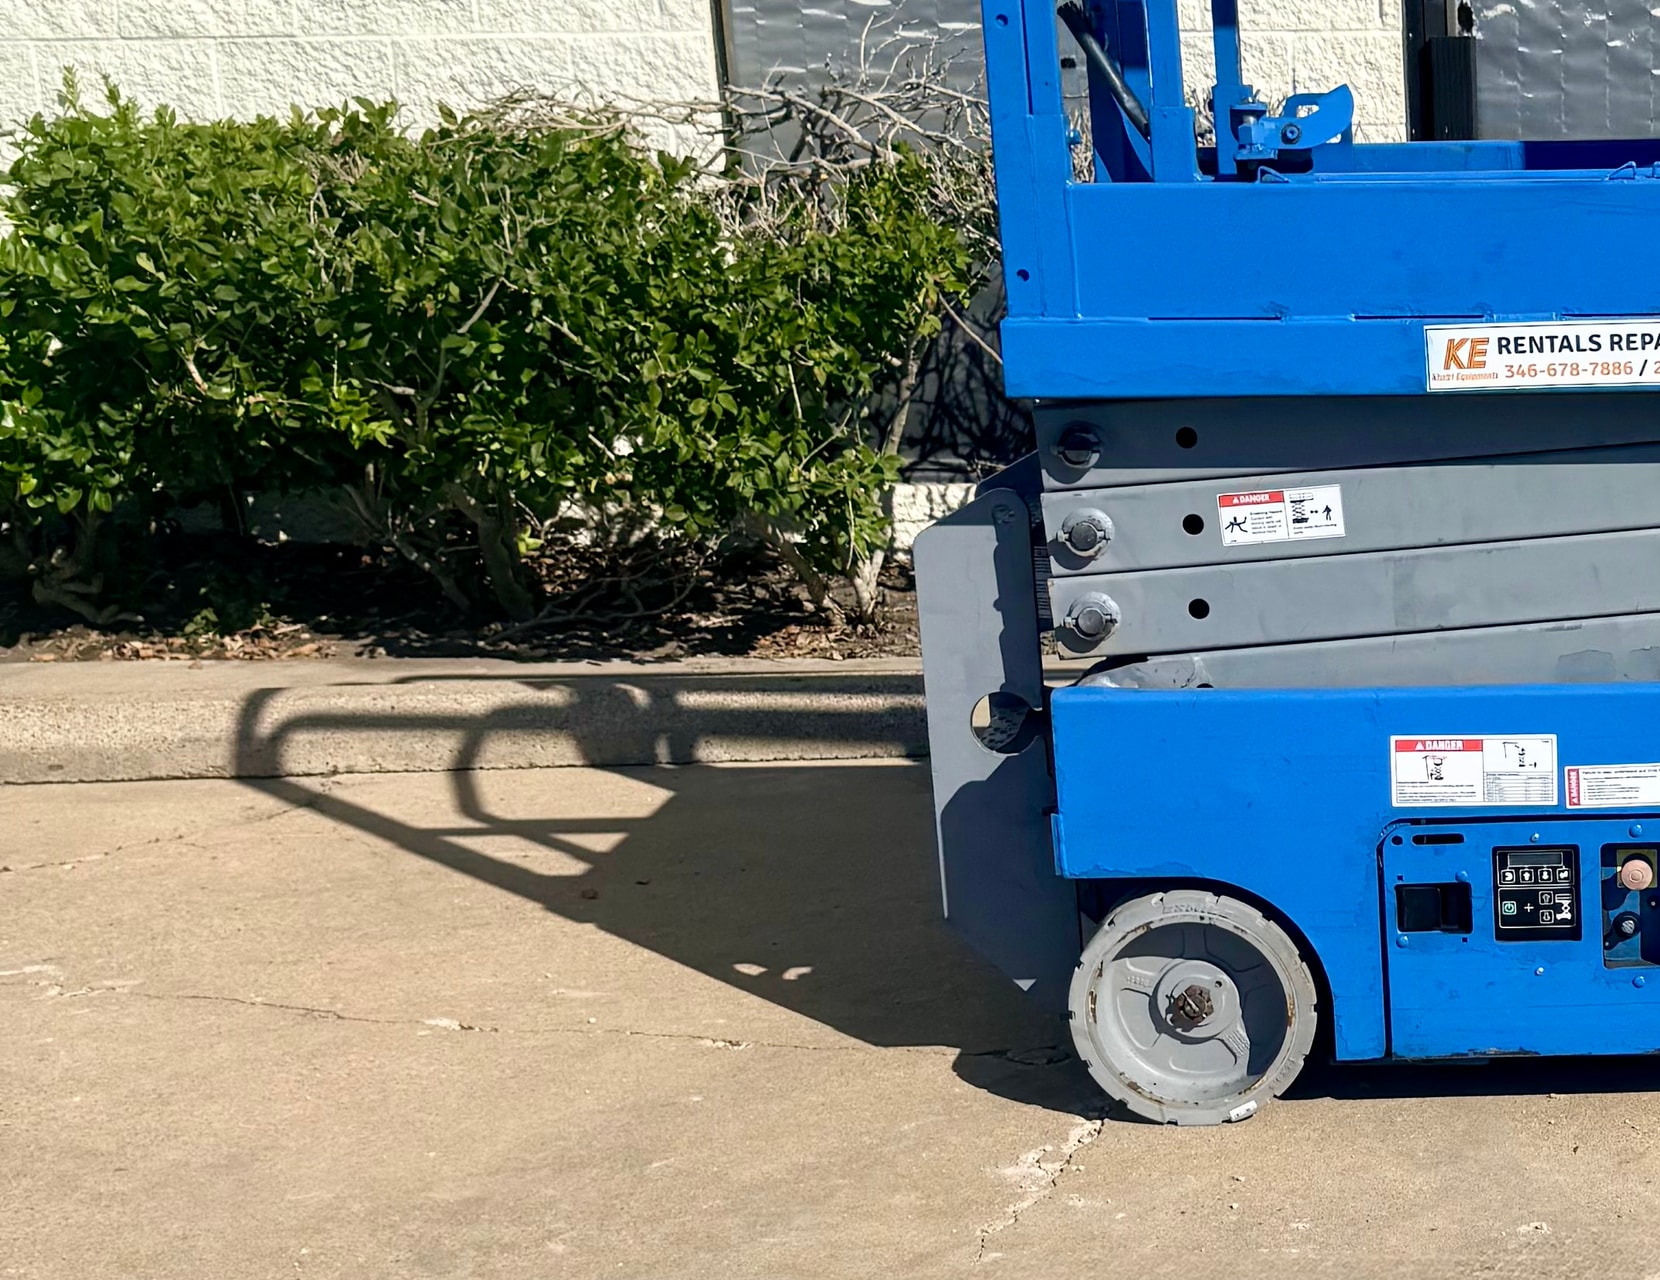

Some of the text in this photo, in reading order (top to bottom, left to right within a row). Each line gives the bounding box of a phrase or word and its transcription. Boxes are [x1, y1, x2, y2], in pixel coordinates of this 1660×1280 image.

[1497, 333, 1602, 355] RENTALS
[1443, 336, 1490, 371] KE
[1504, 361, 1634, 379] 346-678-7886
[1239, 494, 1271, 504] DANGER
[1425, 740, 1464, 751] DANGER
